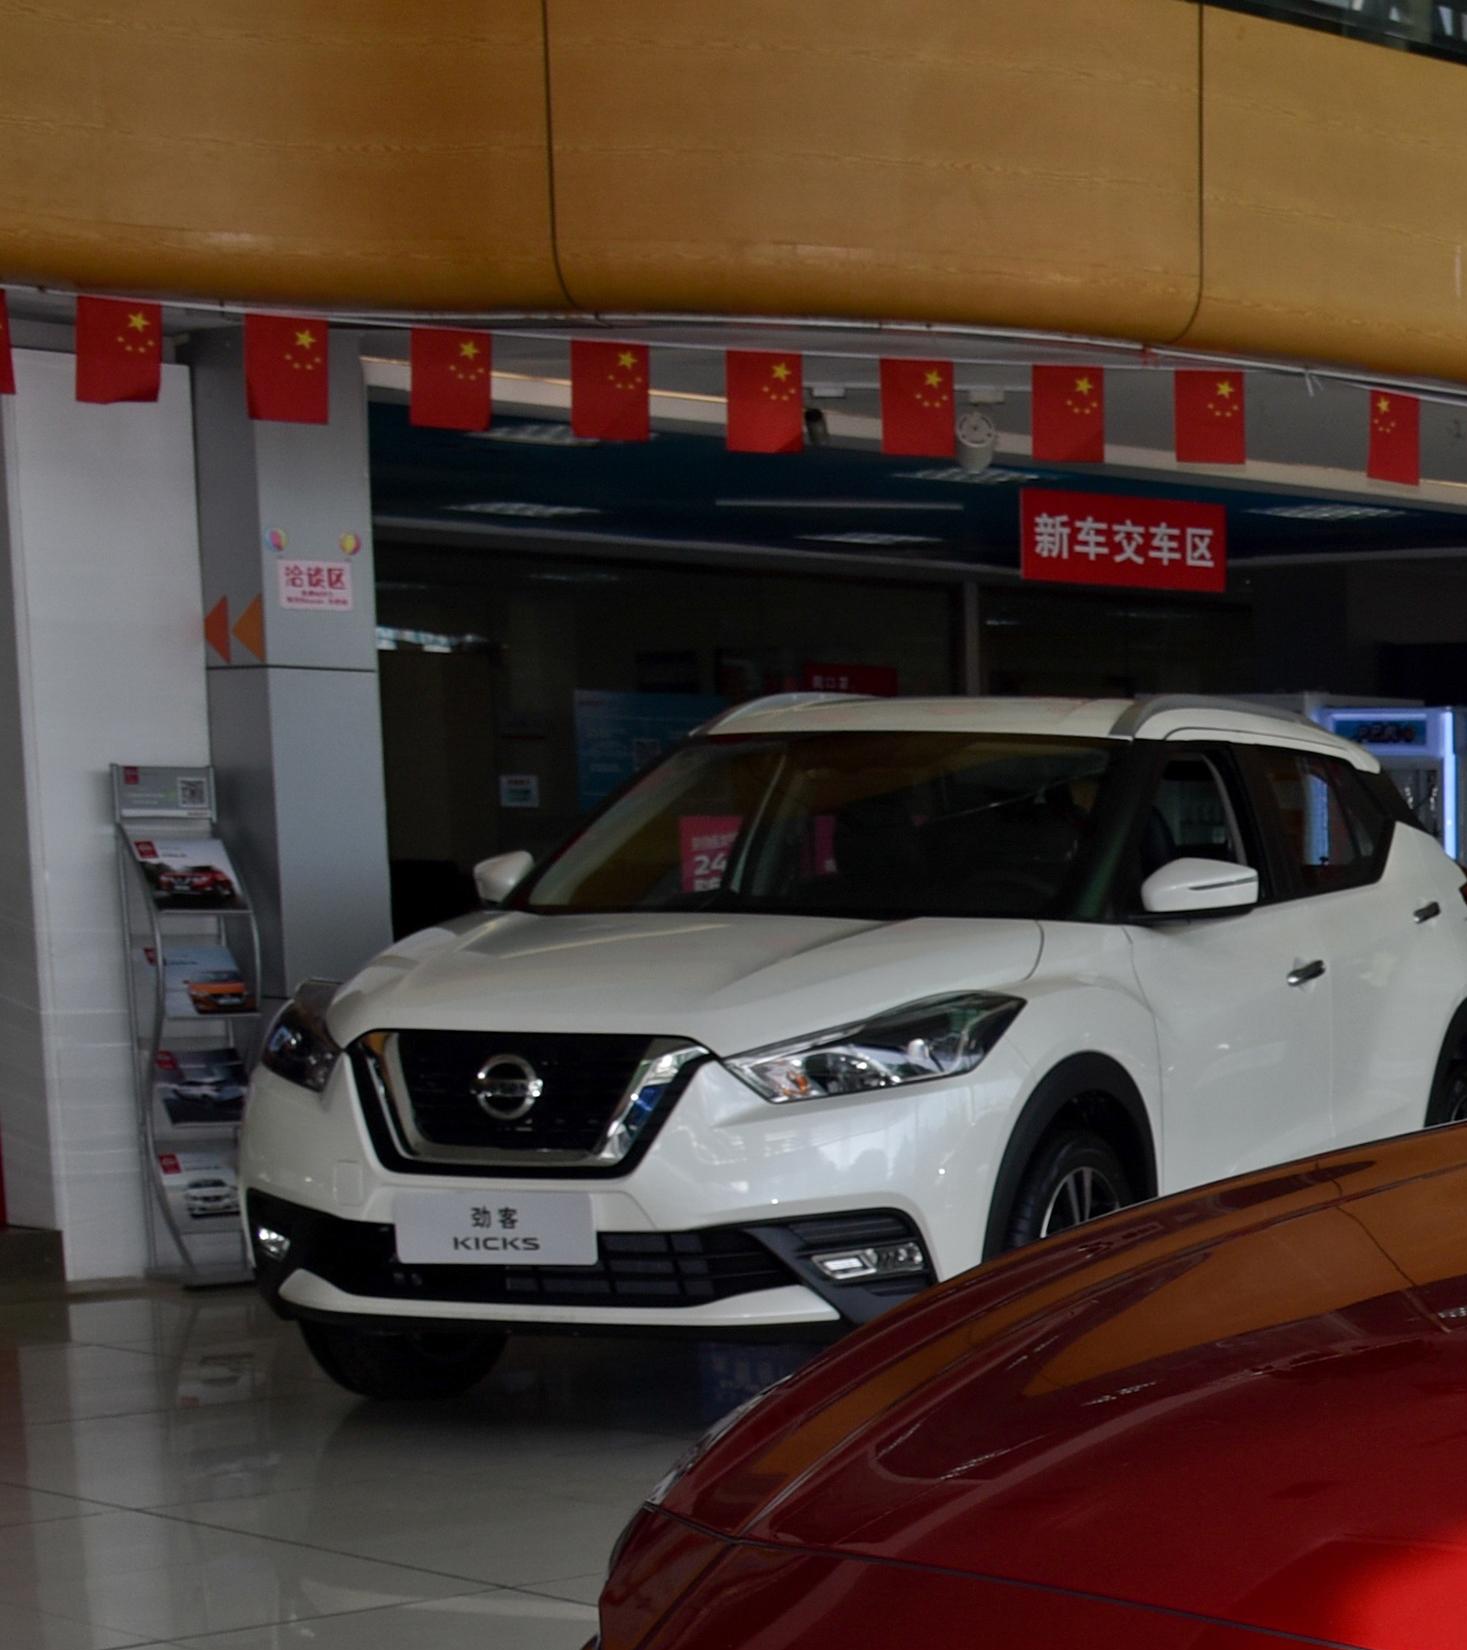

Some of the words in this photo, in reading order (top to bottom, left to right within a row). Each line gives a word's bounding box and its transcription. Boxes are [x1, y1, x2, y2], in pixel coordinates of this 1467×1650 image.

[1033, 512, 1215, 568] 新车交车区
[471, 1205, 518, 1230] 劲客
[453, 1236, 541, 1251] KICKS
